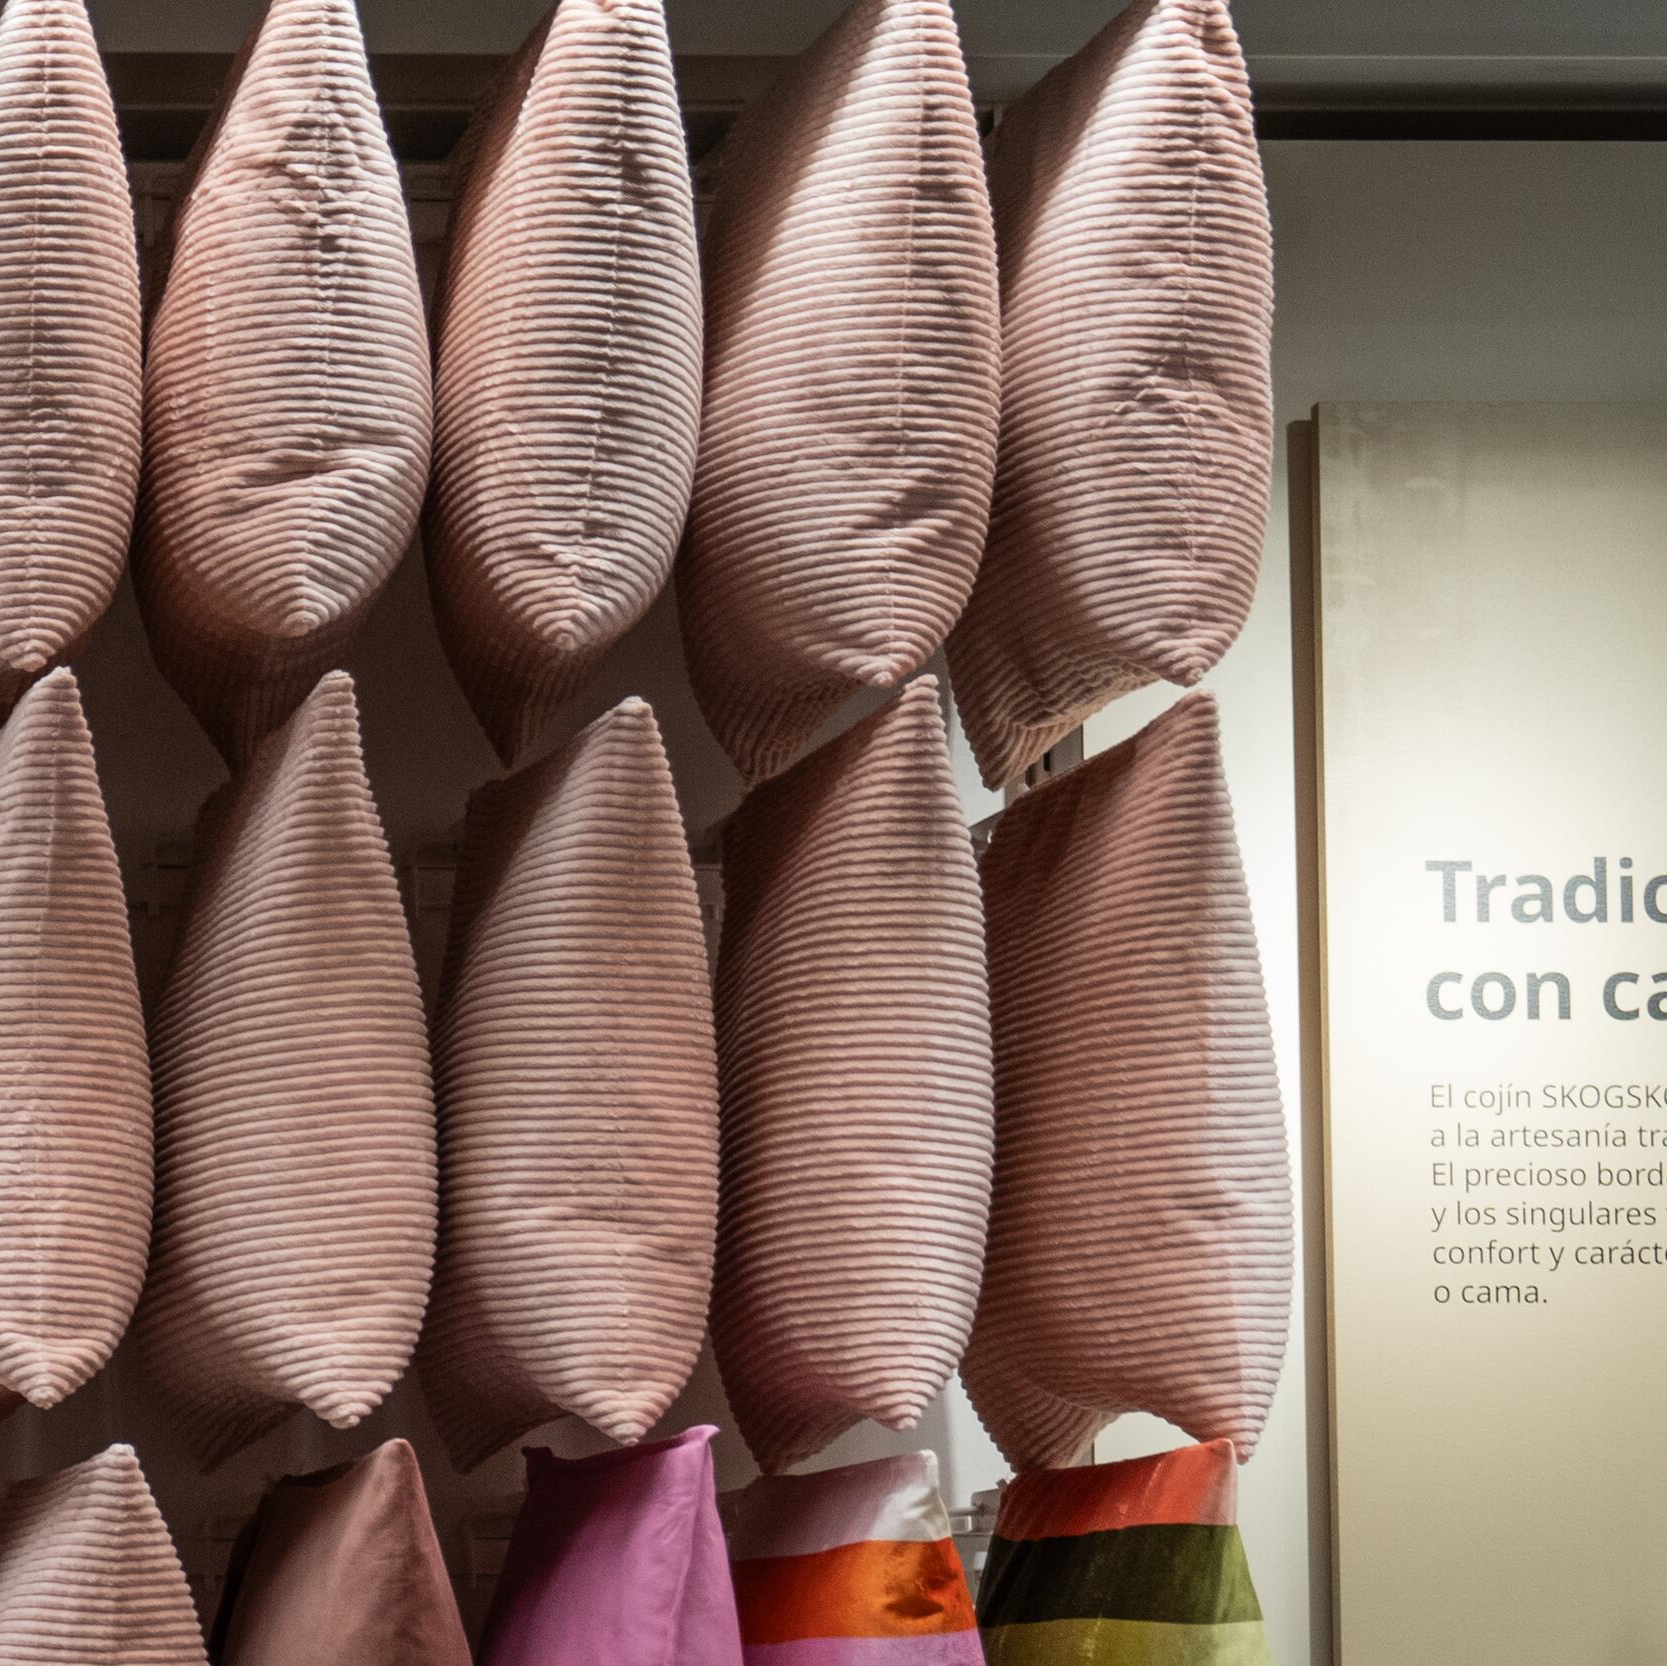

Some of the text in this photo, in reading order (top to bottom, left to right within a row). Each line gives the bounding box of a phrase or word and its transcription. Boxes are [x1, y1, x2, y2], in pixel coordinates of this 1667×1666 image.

[1425, 970, 1572, 1021] con
[1430, 1083, 1667, 1116] El cojín SKOGSK
[1430, 1129, 1445, 1148] a
[1456, 1121, 1480, 1148] la
[1490, 1121, 1628, 1148] artesanía
[1432, 1160, 1667, 1194] El precioso bord
[1430, 1201, 1657, 1233] y los singulares
[1432, 1239, 1667, 1271] confort y caráct
[1433, 1285, 1548, 1304] o cama.
